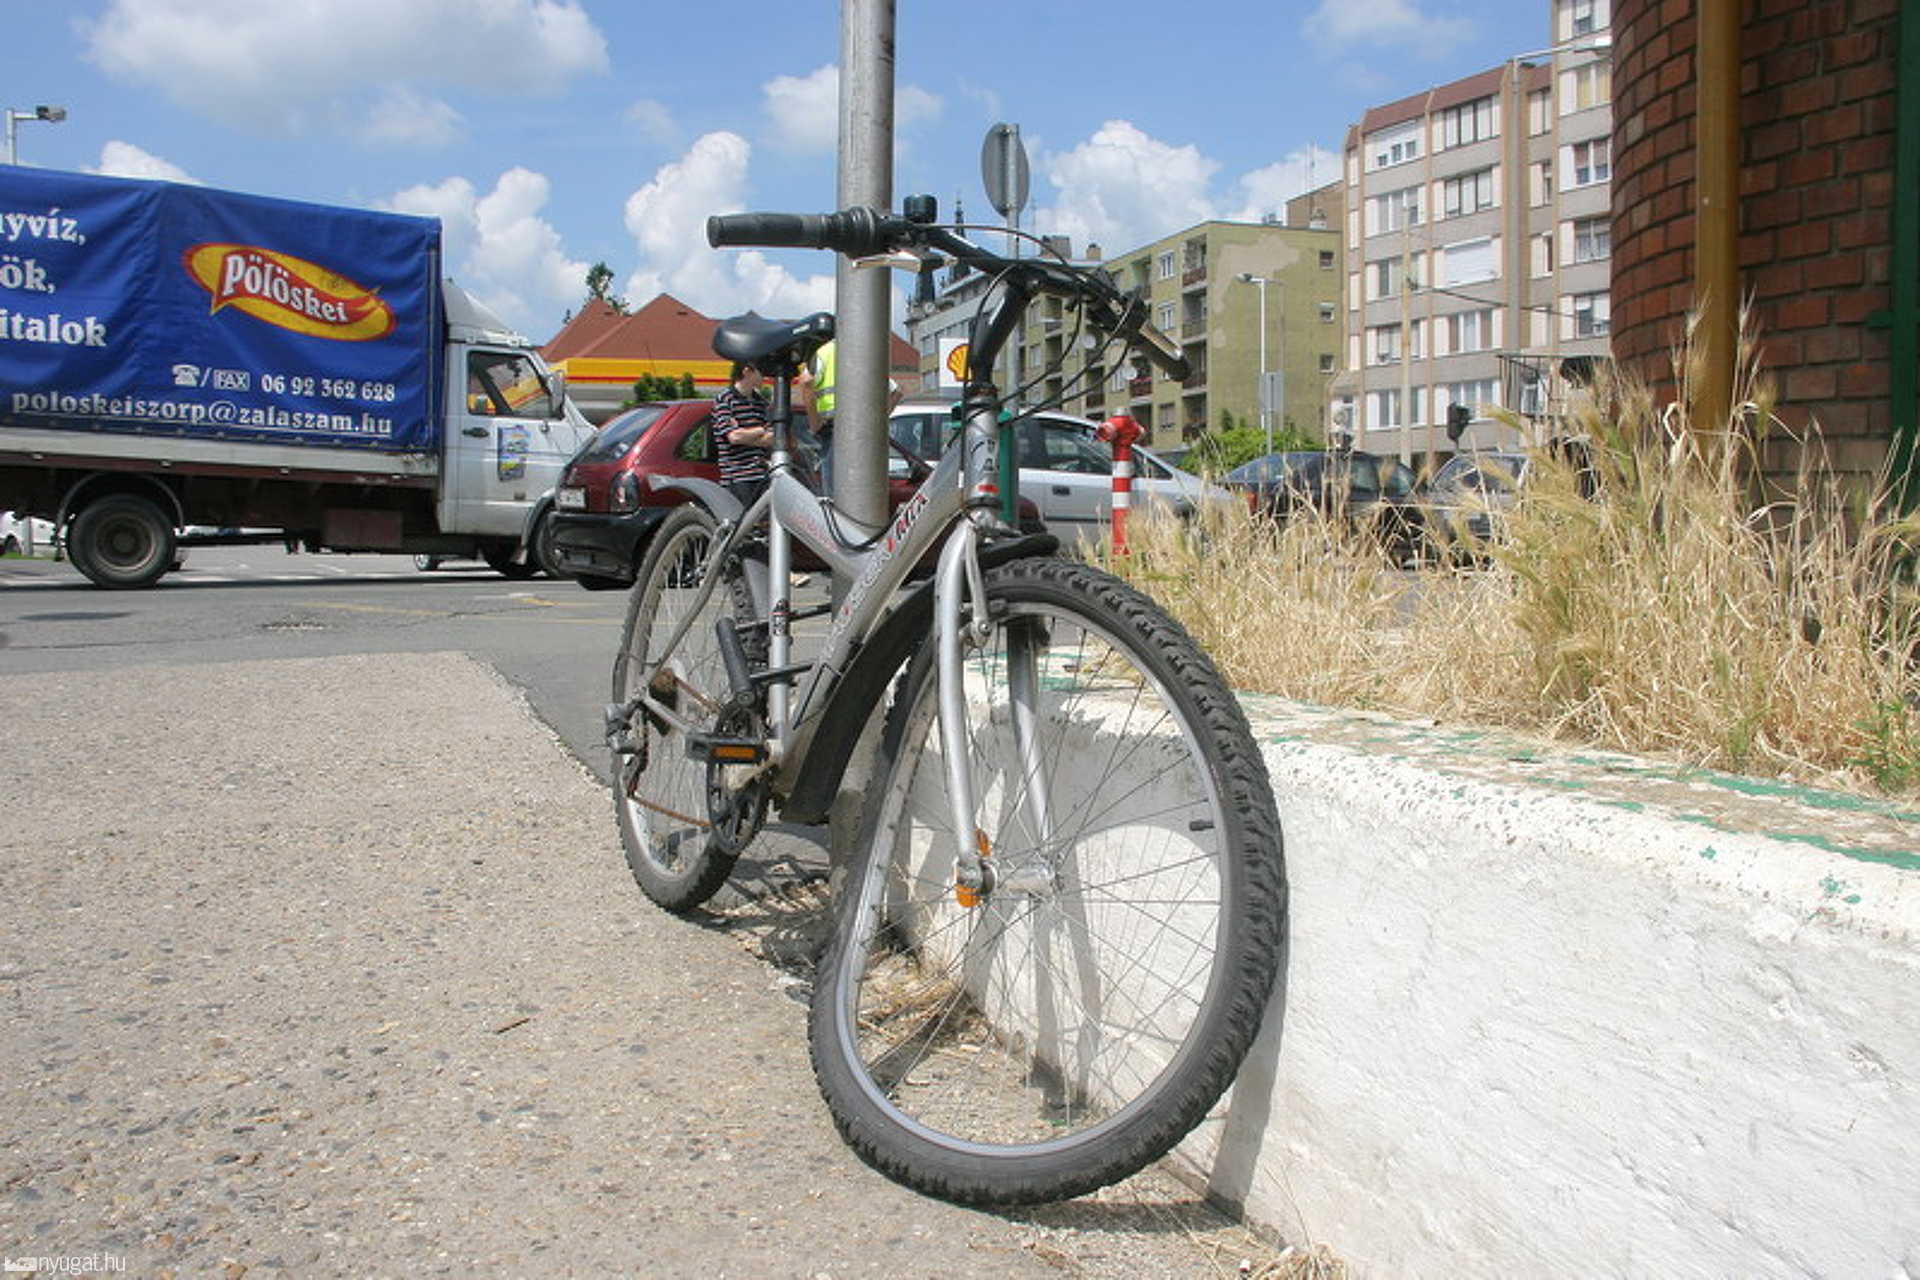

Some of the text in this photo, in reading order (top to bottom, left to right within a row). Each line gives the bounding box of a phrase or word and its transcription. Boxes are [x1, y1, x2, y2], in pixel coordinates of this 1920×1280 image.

[0, 255, 56, 294] ök,
[222, 254, 348, 322] Pölöskei
[0, 308, 107, 347] italok
[261, 374, 285, 393] 06
[291, 377, 316, 396] 92
[321, 378, 357, 399] 362
[361, 382, 395, 401] 628
[12, 389, 393, 434] poloskeiszorp@zalaszam.hu
